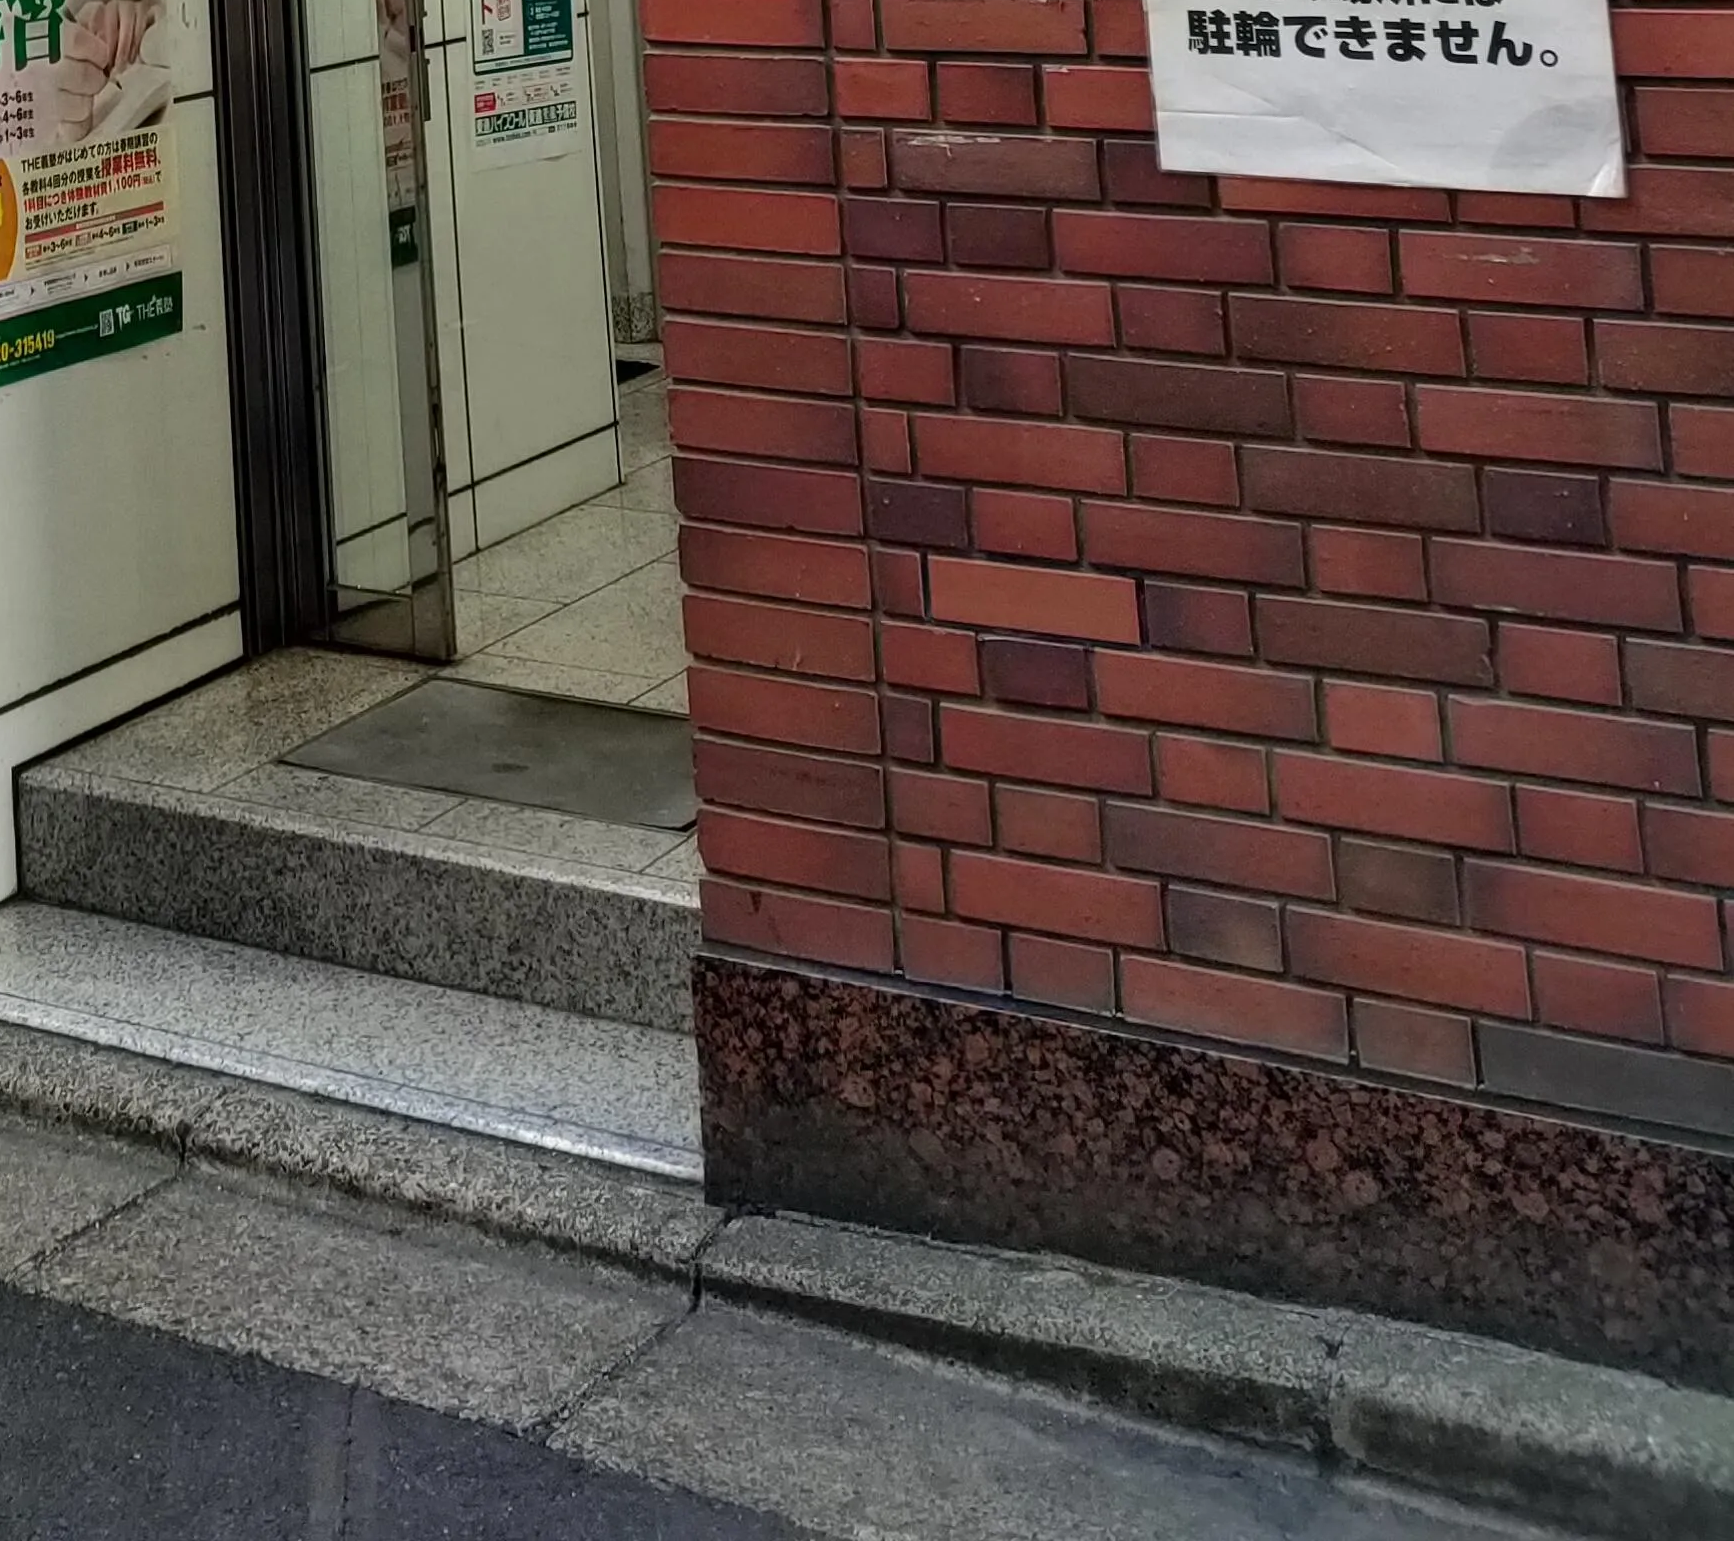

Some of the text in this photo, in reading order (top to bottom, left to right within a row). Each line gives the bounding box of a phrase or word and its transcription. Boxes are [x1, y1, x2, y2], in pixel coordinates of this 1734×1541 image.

[1186, 8, 1561, 69] 駐輪できません。
